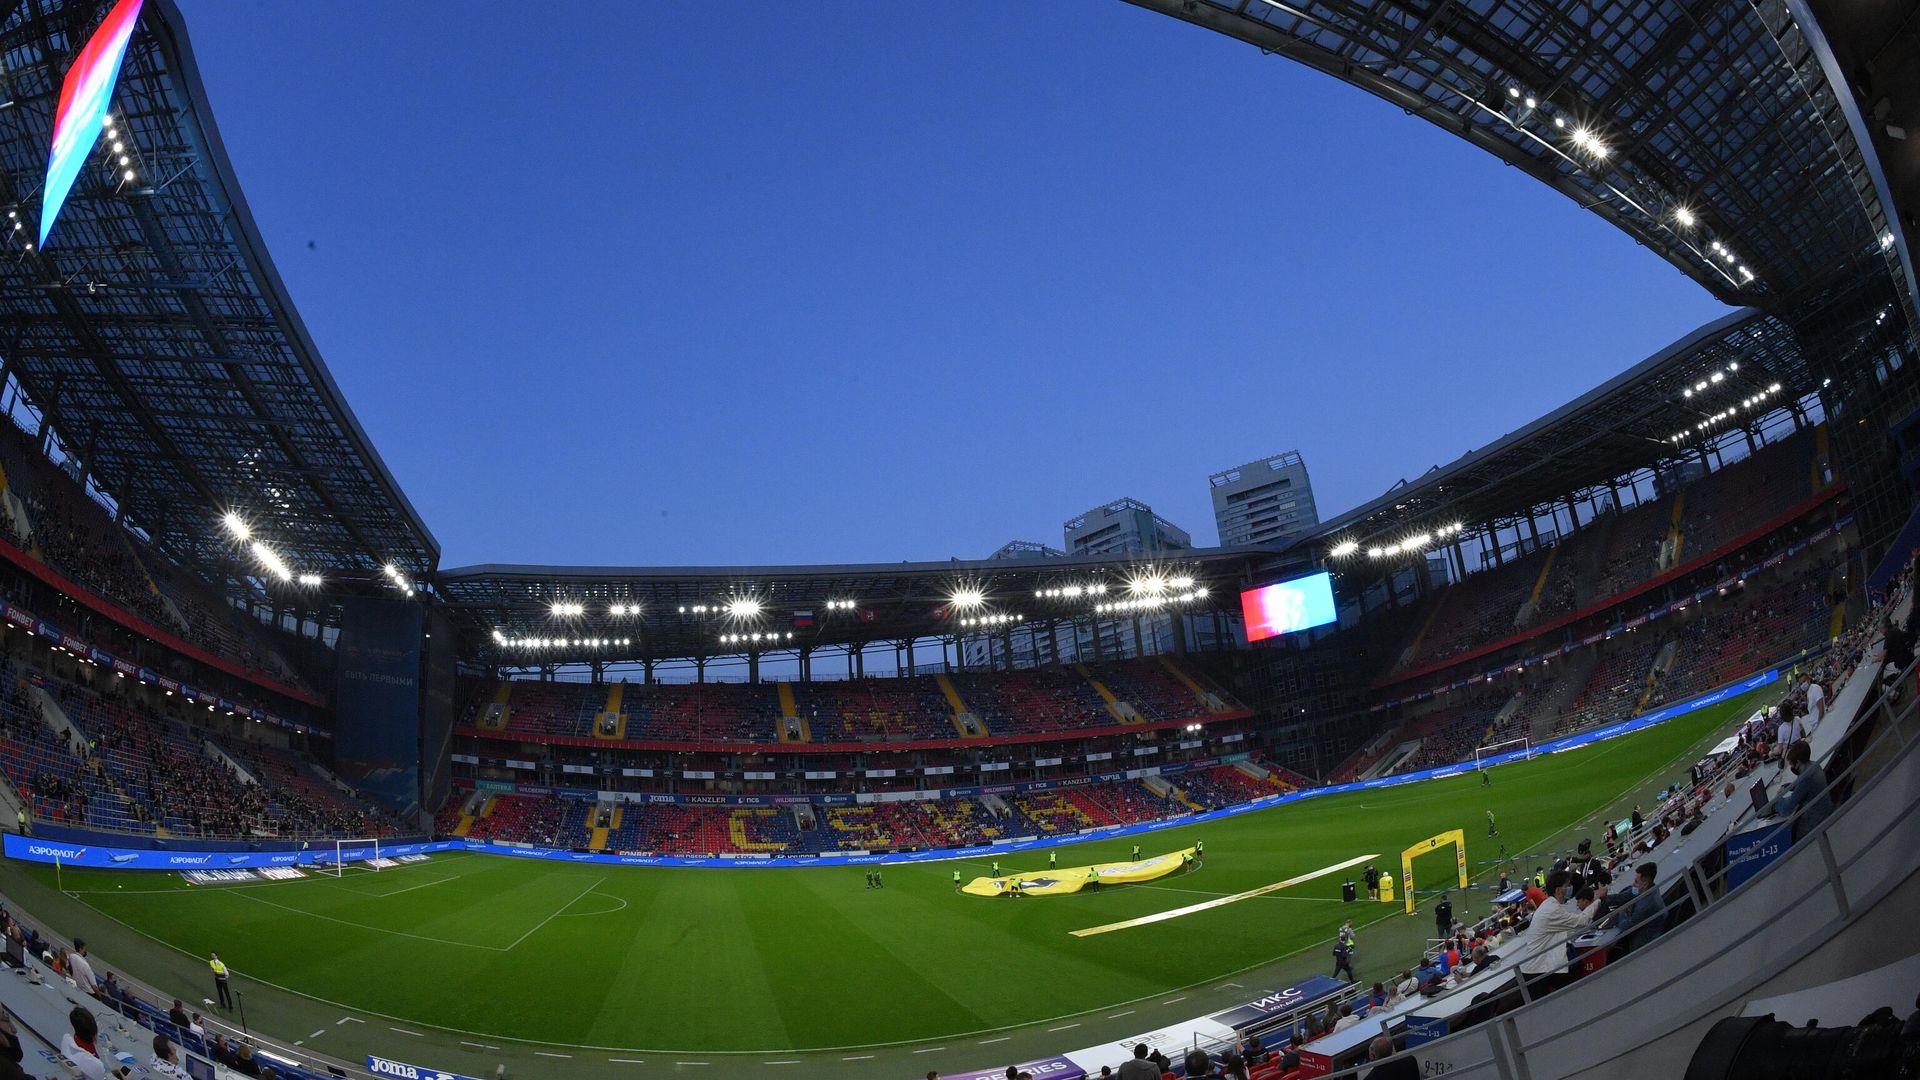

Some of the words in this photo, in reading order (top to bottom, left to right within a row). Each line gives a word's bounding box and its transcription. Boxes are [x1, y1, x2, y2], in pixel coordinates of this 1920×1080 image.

[7, 607, 34, 628] FONBET
[62, 636, 88, 654] FONBET
[114, 659, 136, 674] FONBET
[1062, 777, 1092, 786] KANZLER
[28, 845, 75, 858] АЭРОФЛОТ
[1761, 845, 1778, 857] 1-13
[170, 856, 203, 864] АЭРОФЛОТ
[1250, 987, 1302, 1009] ИКС
[370, 1058, 419, 1080] Joma
[1425, 1060, 1445, 1076] 9-13
